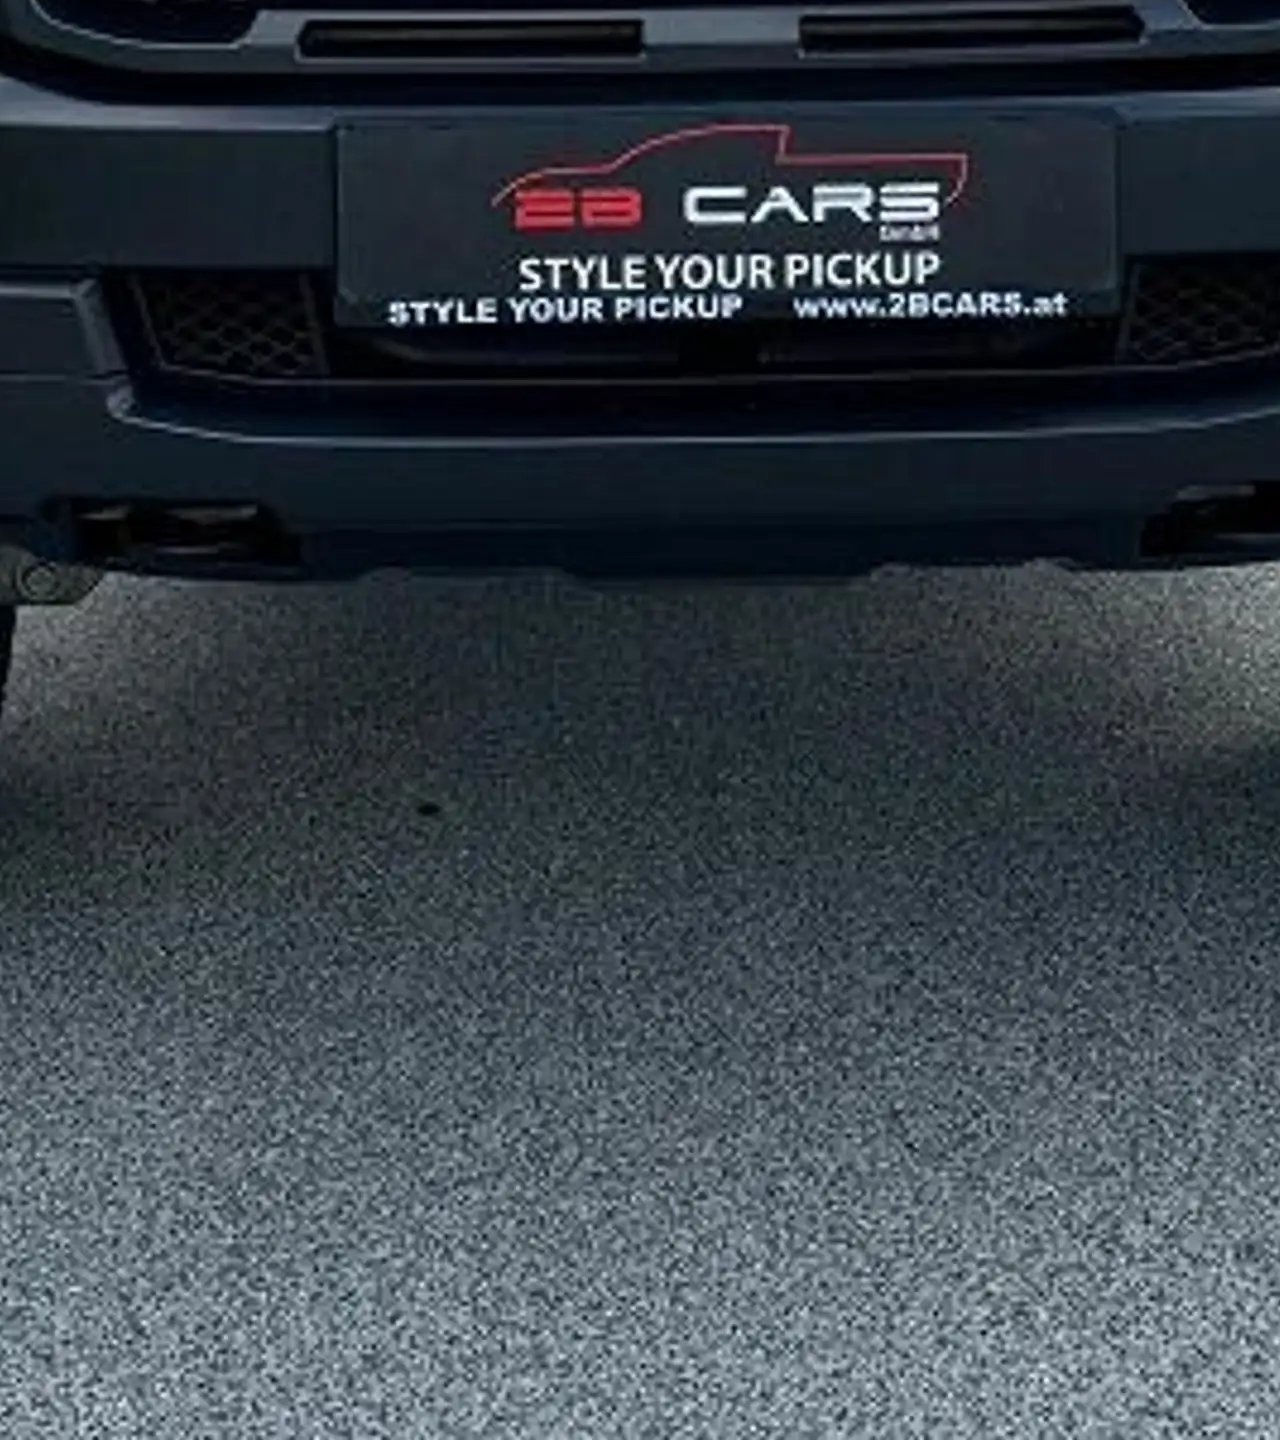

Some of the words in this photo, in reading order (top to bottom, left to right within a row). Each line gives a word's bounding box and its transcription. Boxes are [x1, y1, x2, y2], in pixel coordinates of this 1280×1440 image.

[516, 185, 642, 229] 2B
[683, 182, 940, 224] CARS
[519, 256, 647, 292] STYLE
[654, 254, 776, 291] YOUR
[783, 250, 942, 290] PICKUP
[387, 297, 498, 327] STYLE
[506, 295, 604, 324] YOUR
[613, 292, 743, 321] PICKUP
[792, 289, 1069, 320] www.2BCARS.at
